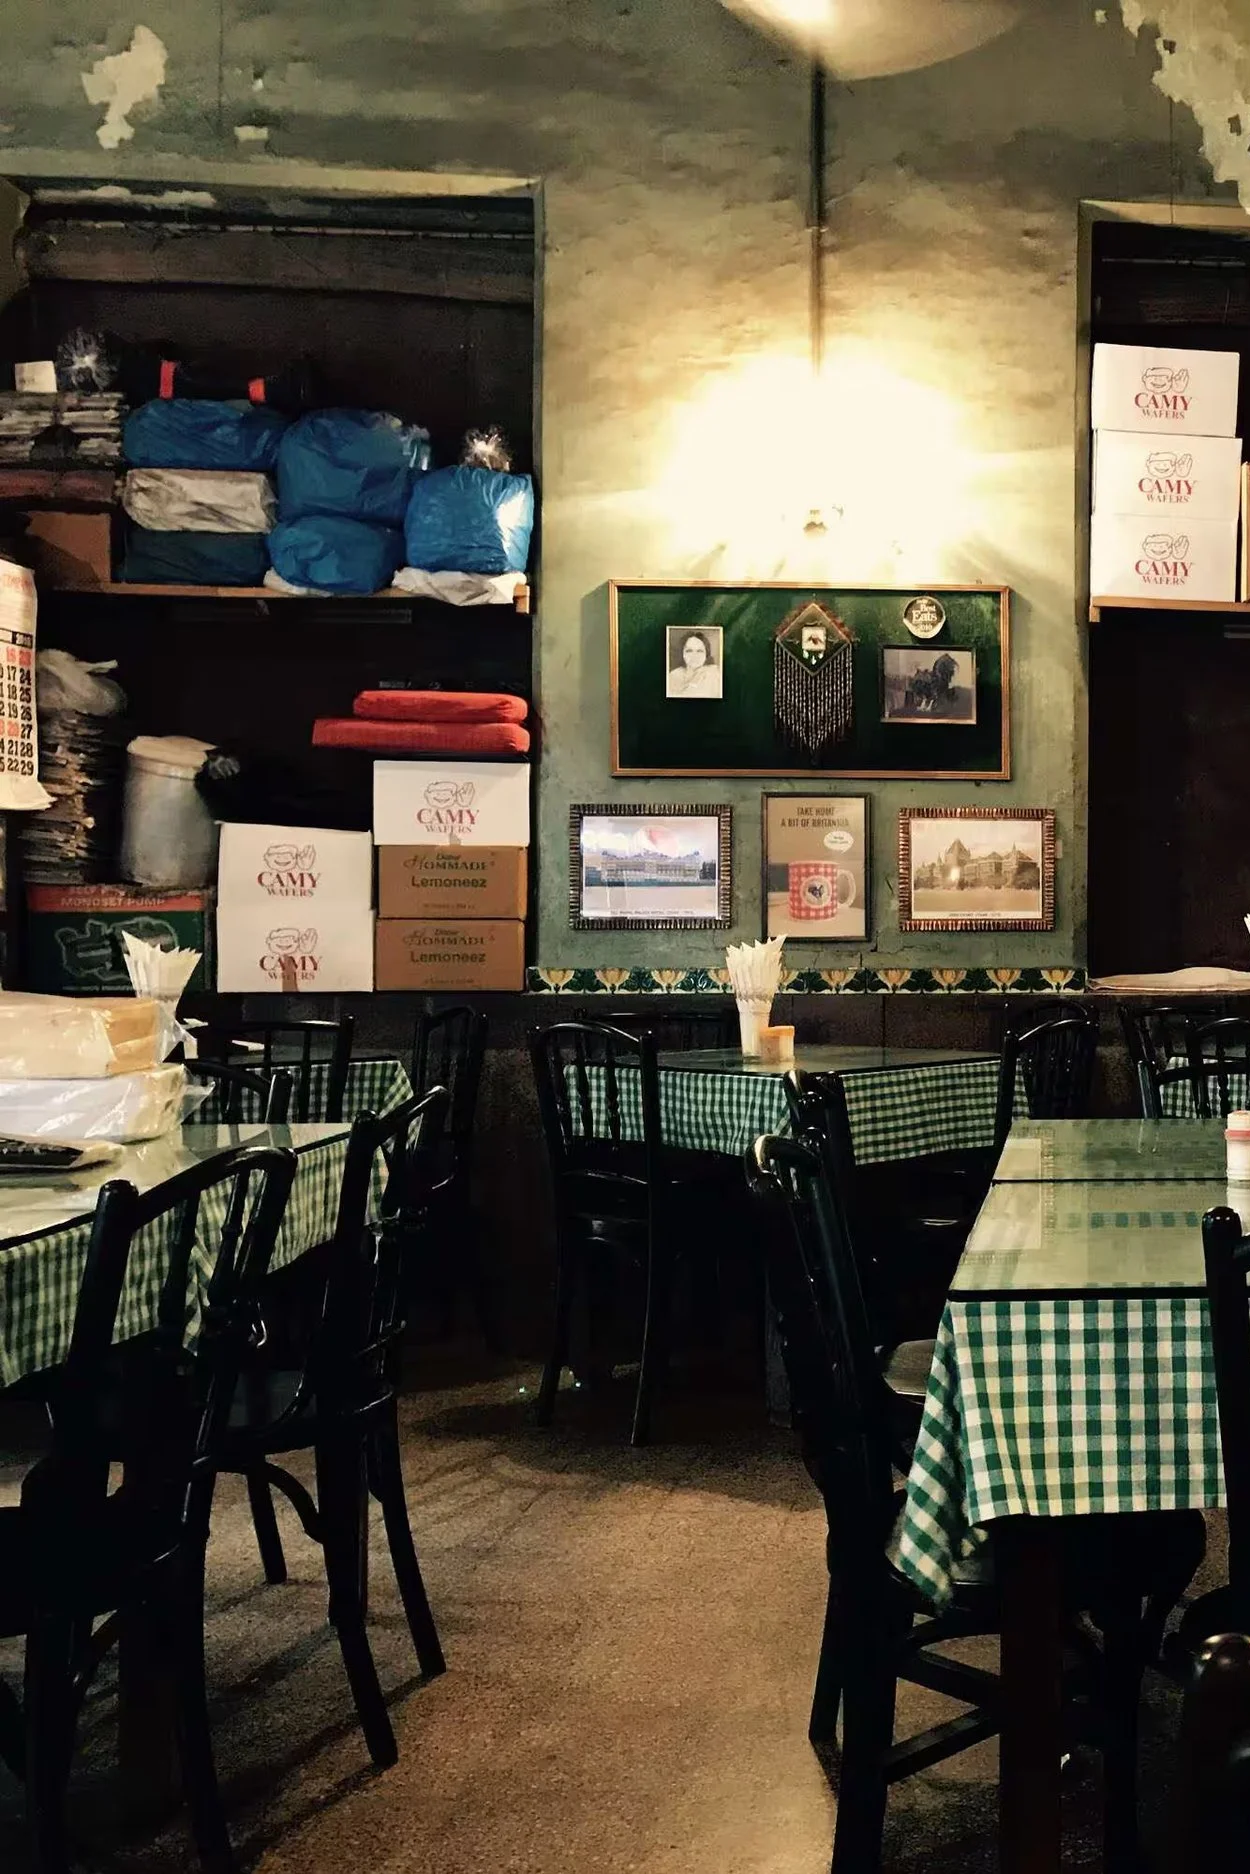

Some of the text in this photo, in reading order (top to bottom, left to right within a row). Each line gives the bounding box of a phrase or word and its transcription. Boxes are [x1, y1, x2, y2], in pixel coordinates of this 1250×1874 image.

[1134, 393, 1192, 411] CAMY
[1141, 409, 1185, 419] WAFERS
[1138, 478, 1198, 496] CAMY
[1146, 494, 1190, 504] WAFERS
[1135, 560, 1194, 577] CAMY
[1142, 576, 1186, 585] WAFERS
[911, 610, 938, 624] Eats
[7, 665, 32, 686] 17 24
[7, 683, 17, 700] 18
[19, 687, 32, 704] 25
[8, 702, 18, 719] 19
[20, 723, 33, 739] 27
[7, 739, 18, 756] 21
[20, 742, 33, 758] 28
[7, 758, 19, 772] 22
[20, 760, 34, 776] 29
[417, 808, 480, 825] CAMY
[797, 807, 814, 816] TAKE
[780, 819, 787, 828] A
[788, 819, 799, 828] BIT
[800, 819, 810, 828] OF
[257, 871, 321, 888] CAMY
[411, 876, 487, 888] Lemoneez
[267, 887, 315, 897] WAFERS
[259, 955, 323, 971] CAMY
[410, 951, 487, 963] Lemoneez
